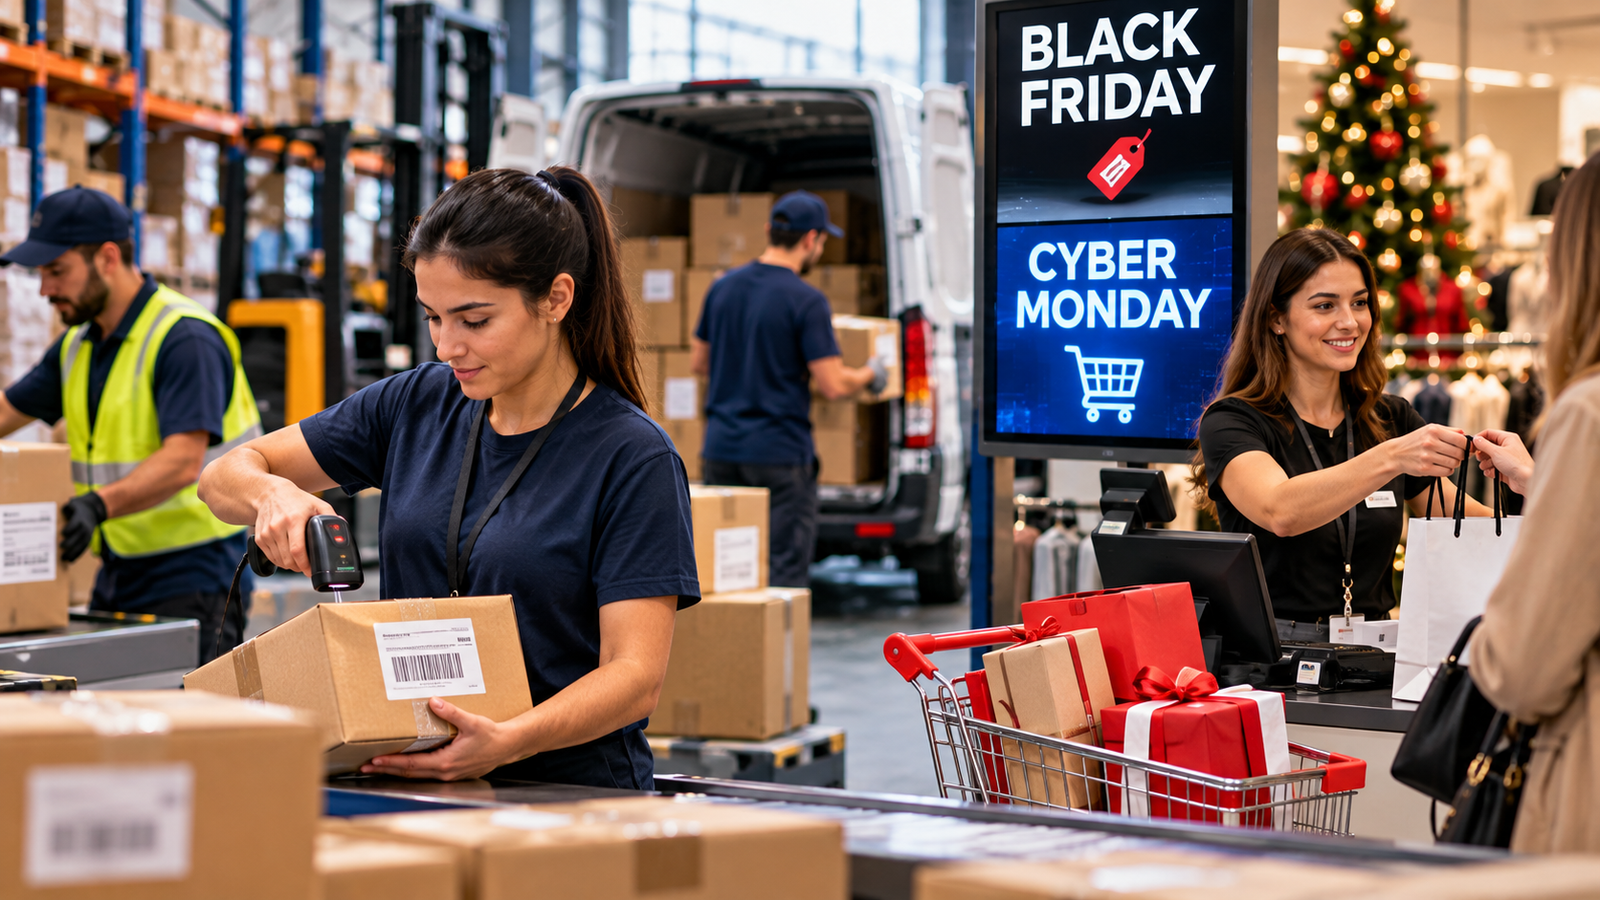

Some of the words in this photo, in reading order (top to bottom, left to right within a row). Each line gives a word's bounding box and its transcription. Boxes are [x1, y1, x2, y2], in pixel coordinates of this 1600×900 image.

[1021, 8, 1201, 72] BLACK
[1021, 64, 1216, 127] FRIDAY
[1028, 239, 1177, 281] CYBER
[1016, 289, 1213, 329] MONDAY
